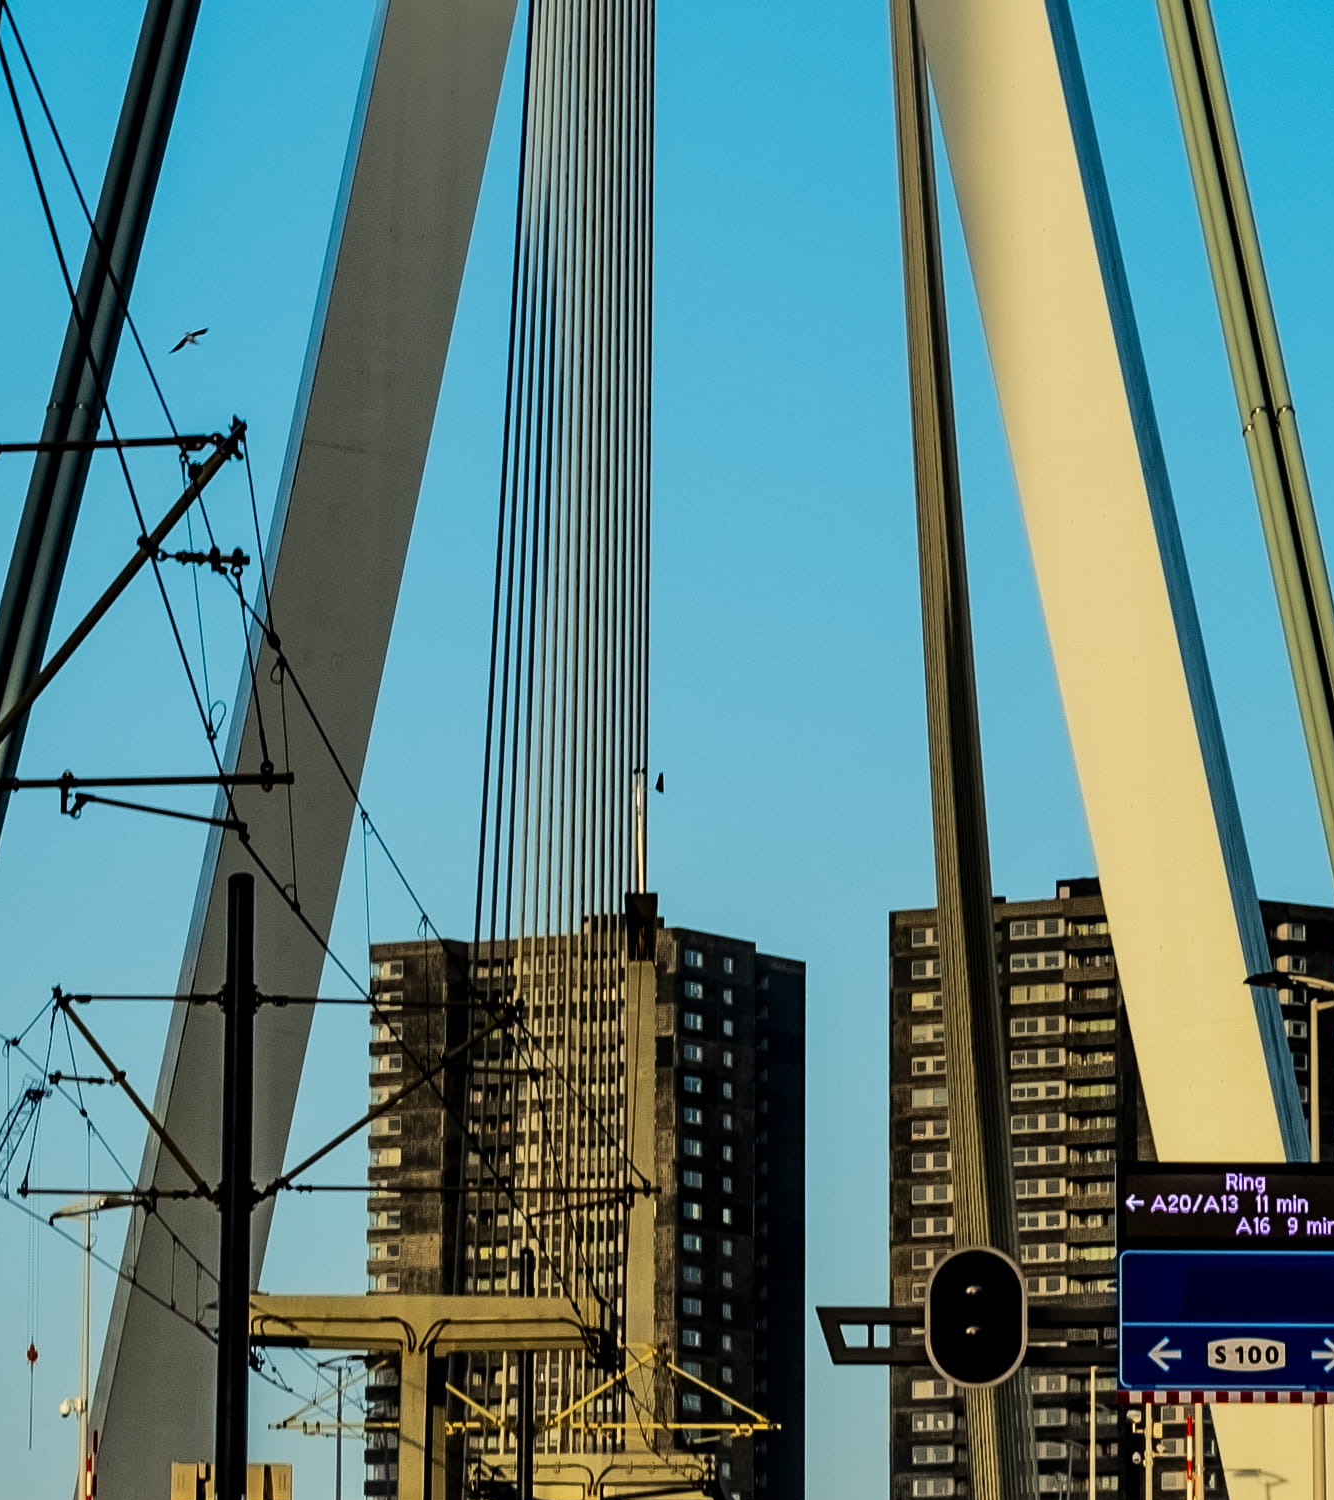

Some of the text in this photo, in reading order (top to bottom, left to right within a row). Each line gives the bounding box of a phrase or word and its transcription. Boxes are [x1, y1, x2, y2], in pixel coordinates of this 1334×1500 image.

[1225, 1172, 1266, 1194] Ring
[1150, 1194, 1309, 1214] A20/A13 11 min
[1235, 1217, 1271, 1236] A16
[1287, 1217, 1299, 1236] 9
[1214, 1345, 1280, 1365] S 100
